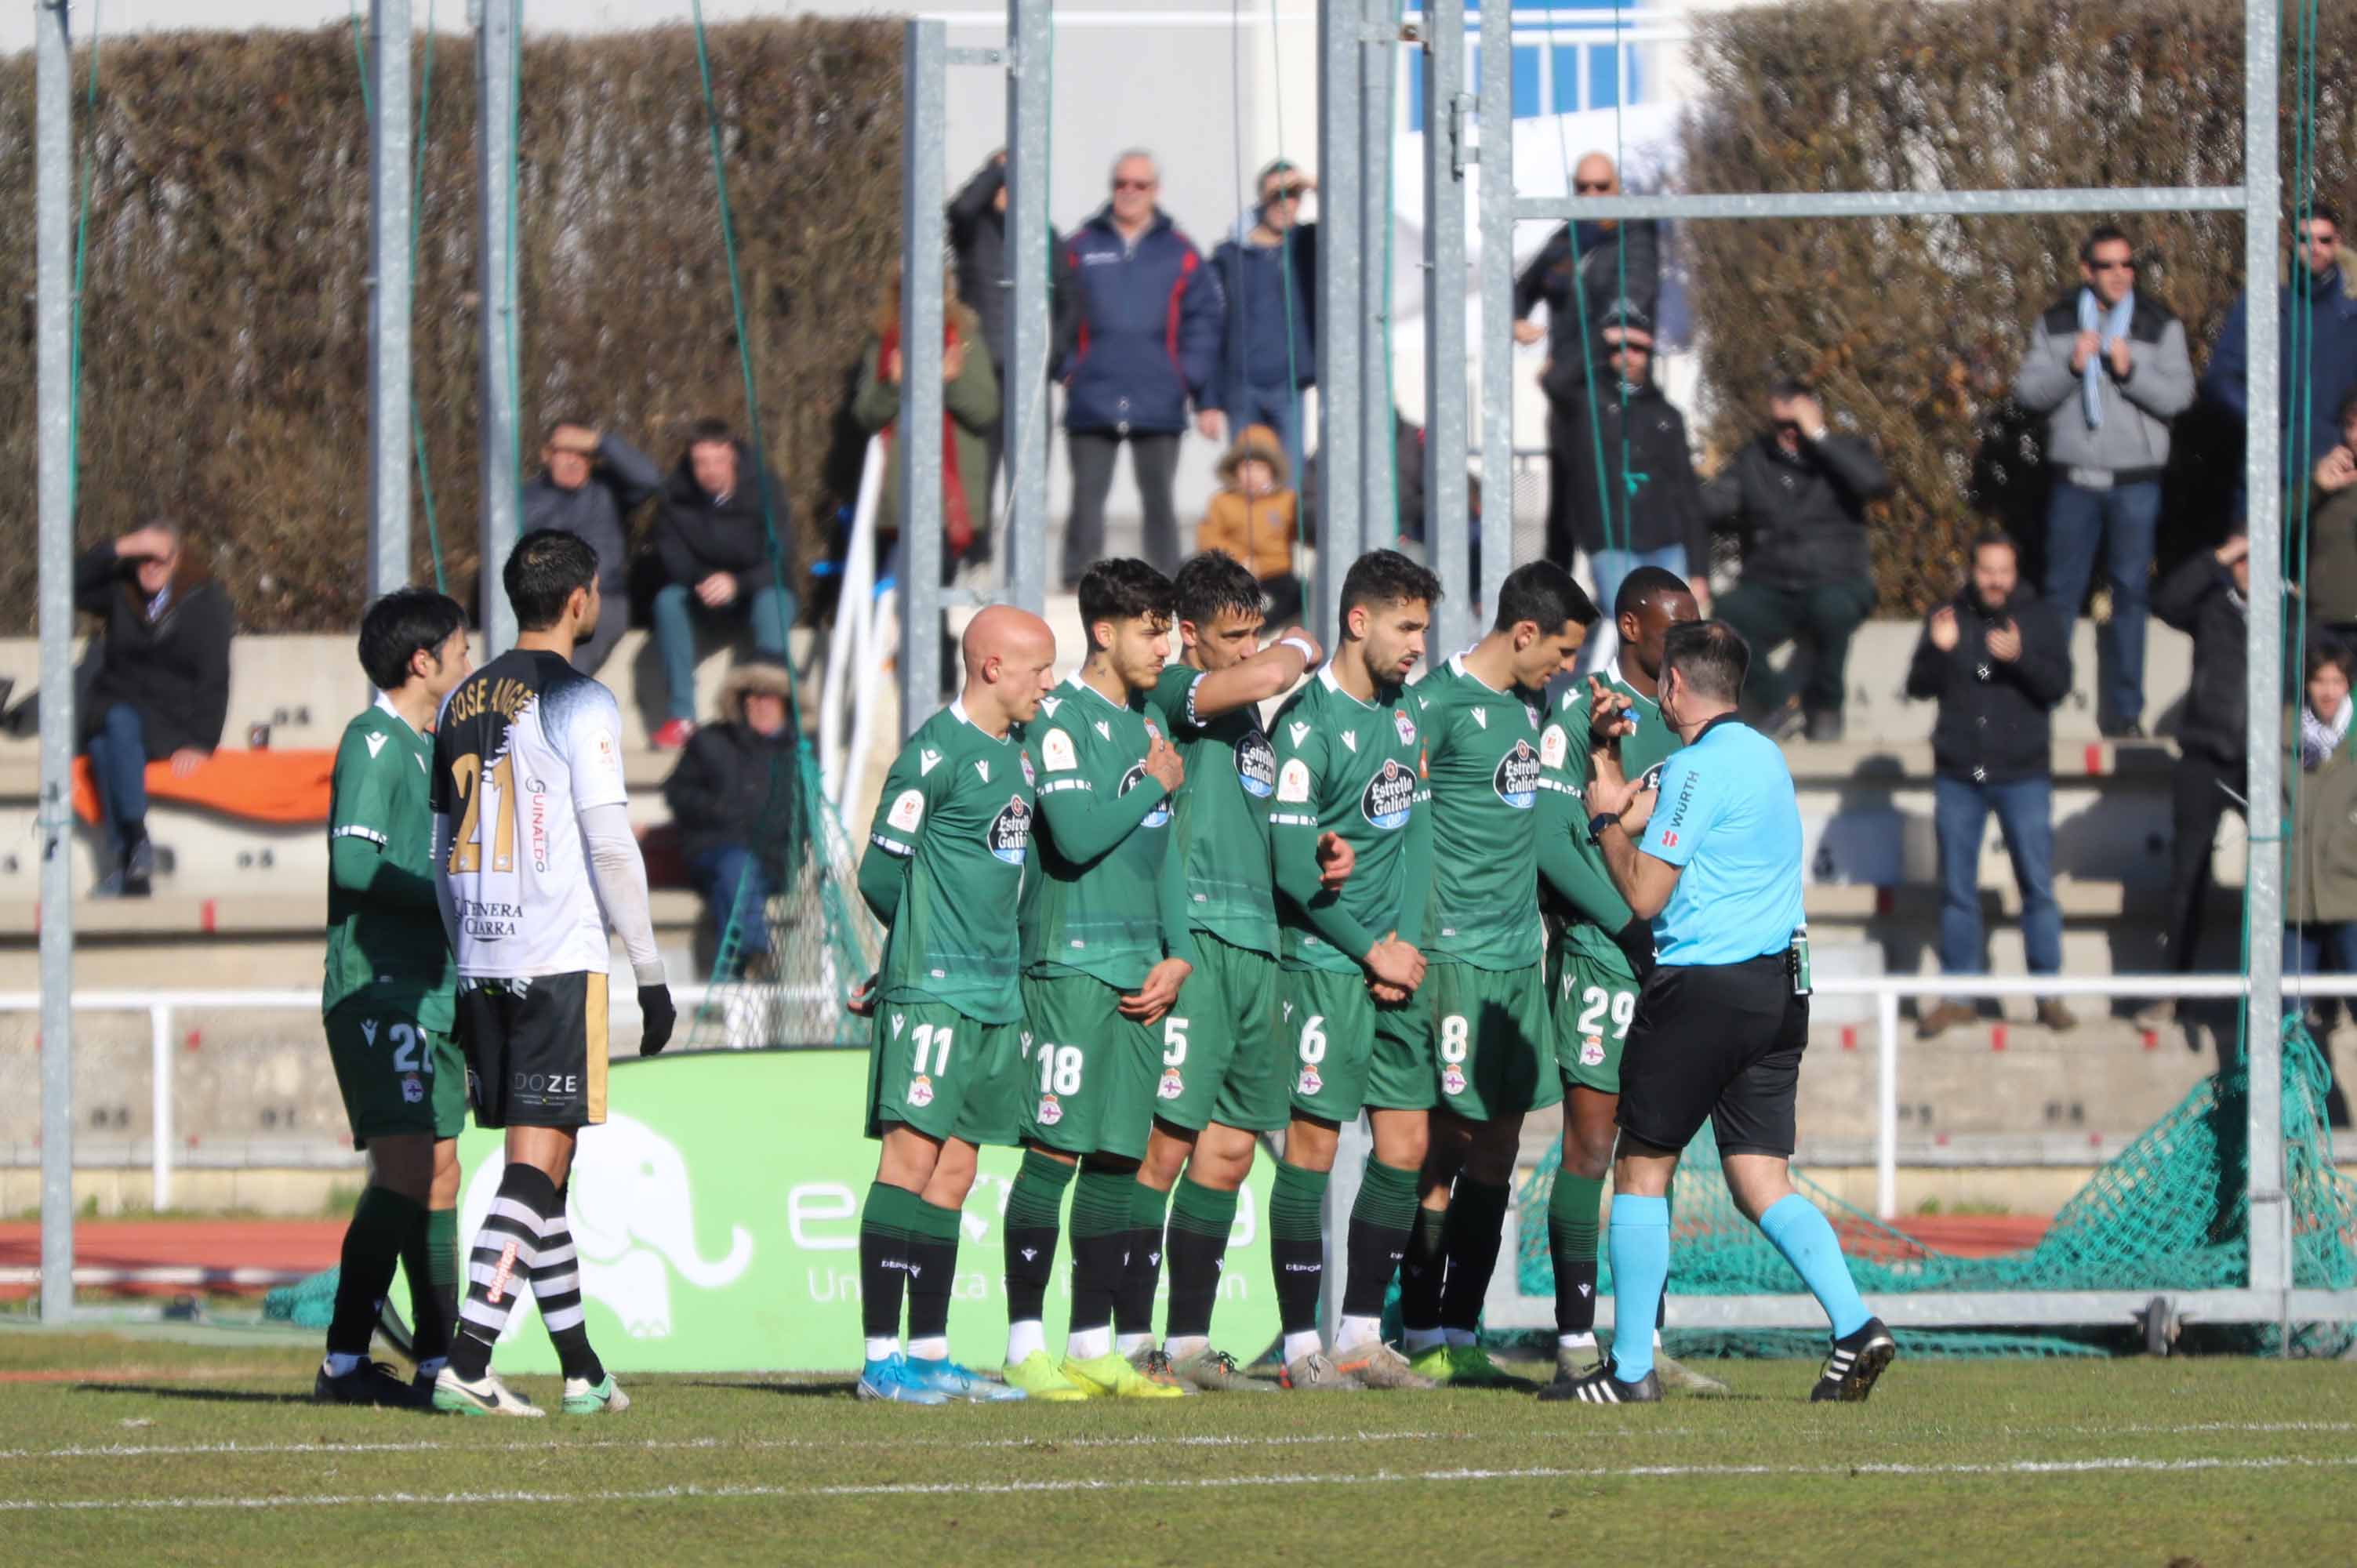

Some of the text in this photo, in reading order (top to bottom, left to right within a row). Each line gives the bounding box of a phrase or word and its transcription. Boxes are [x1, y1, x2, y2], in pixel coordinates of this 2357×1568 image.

[451, 678, 488, 728] JOSE
[1371, 776, 1412, 800] Estrella
[1505, 760, 1539, 778] Estrella
[1505, 777, 1538, 794] Galicia
[449, 753, 514, 873] 21
[1374, 791, 1411, 815] Galicia
[1670, 770, 1700, 828] WÜRTH
[525, 776, 547, 873] GUINALDO
[997, 815, 1030, 832] Estrell
[1577, 986, 1635, 1040] 29
[911, 1023, 953, 1077] 11
[1162, 1017, 1189, 1066] 5
[1298, 1015, 1326, 1063] 6
[1440, 1015, 1469, 1063] 8
[514, 1072, 577, 1093] DOZE
[1037, 1043, 1083, 1096] 18
